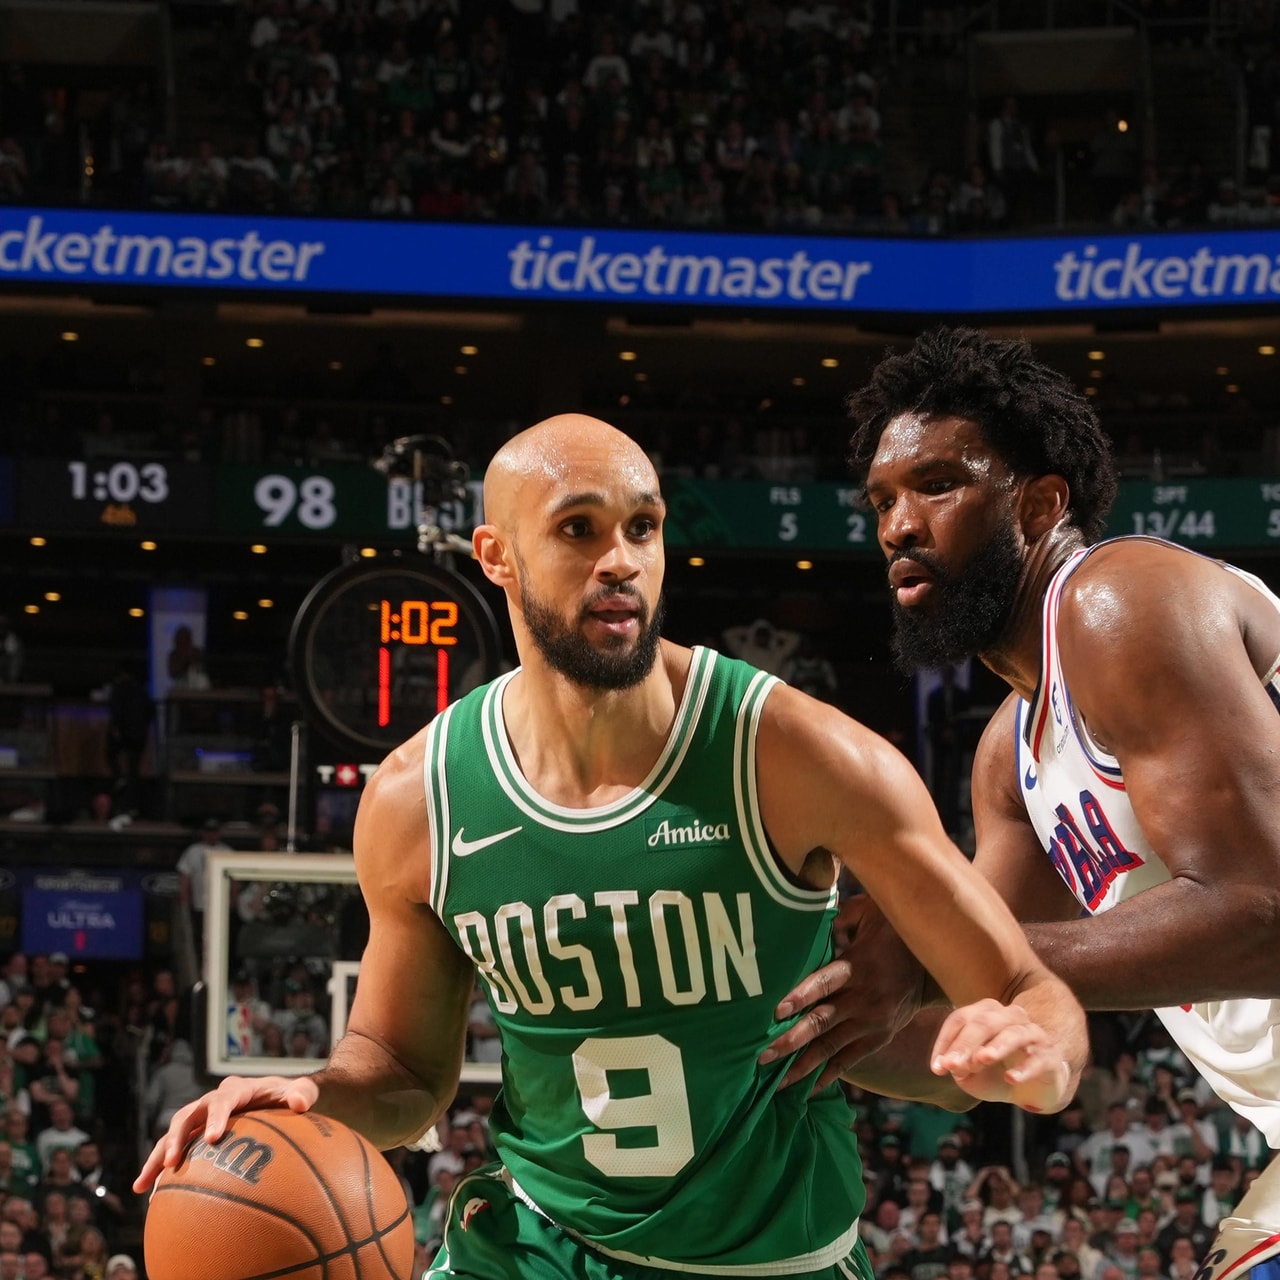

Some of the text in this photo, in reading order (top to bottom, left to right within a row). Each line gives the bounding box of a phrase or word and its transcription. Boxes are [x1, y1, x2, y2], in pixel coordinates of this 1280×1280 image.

[510, 236, 870, 302] ticketmaster
[68, 462, 169, 503] 1:03
[254, 474, 336, 530] 98
[778, 513, 799, 541] 5
[846, 514, 866, 542] 2
[380, 600, 458, 644] 1:02
[378, 647, 448, 727] 11
[648, 820, 730, 846] Amica
[454, 890, 763, 1015] BOSTON
[572, 1034, 695, 1177] 9
